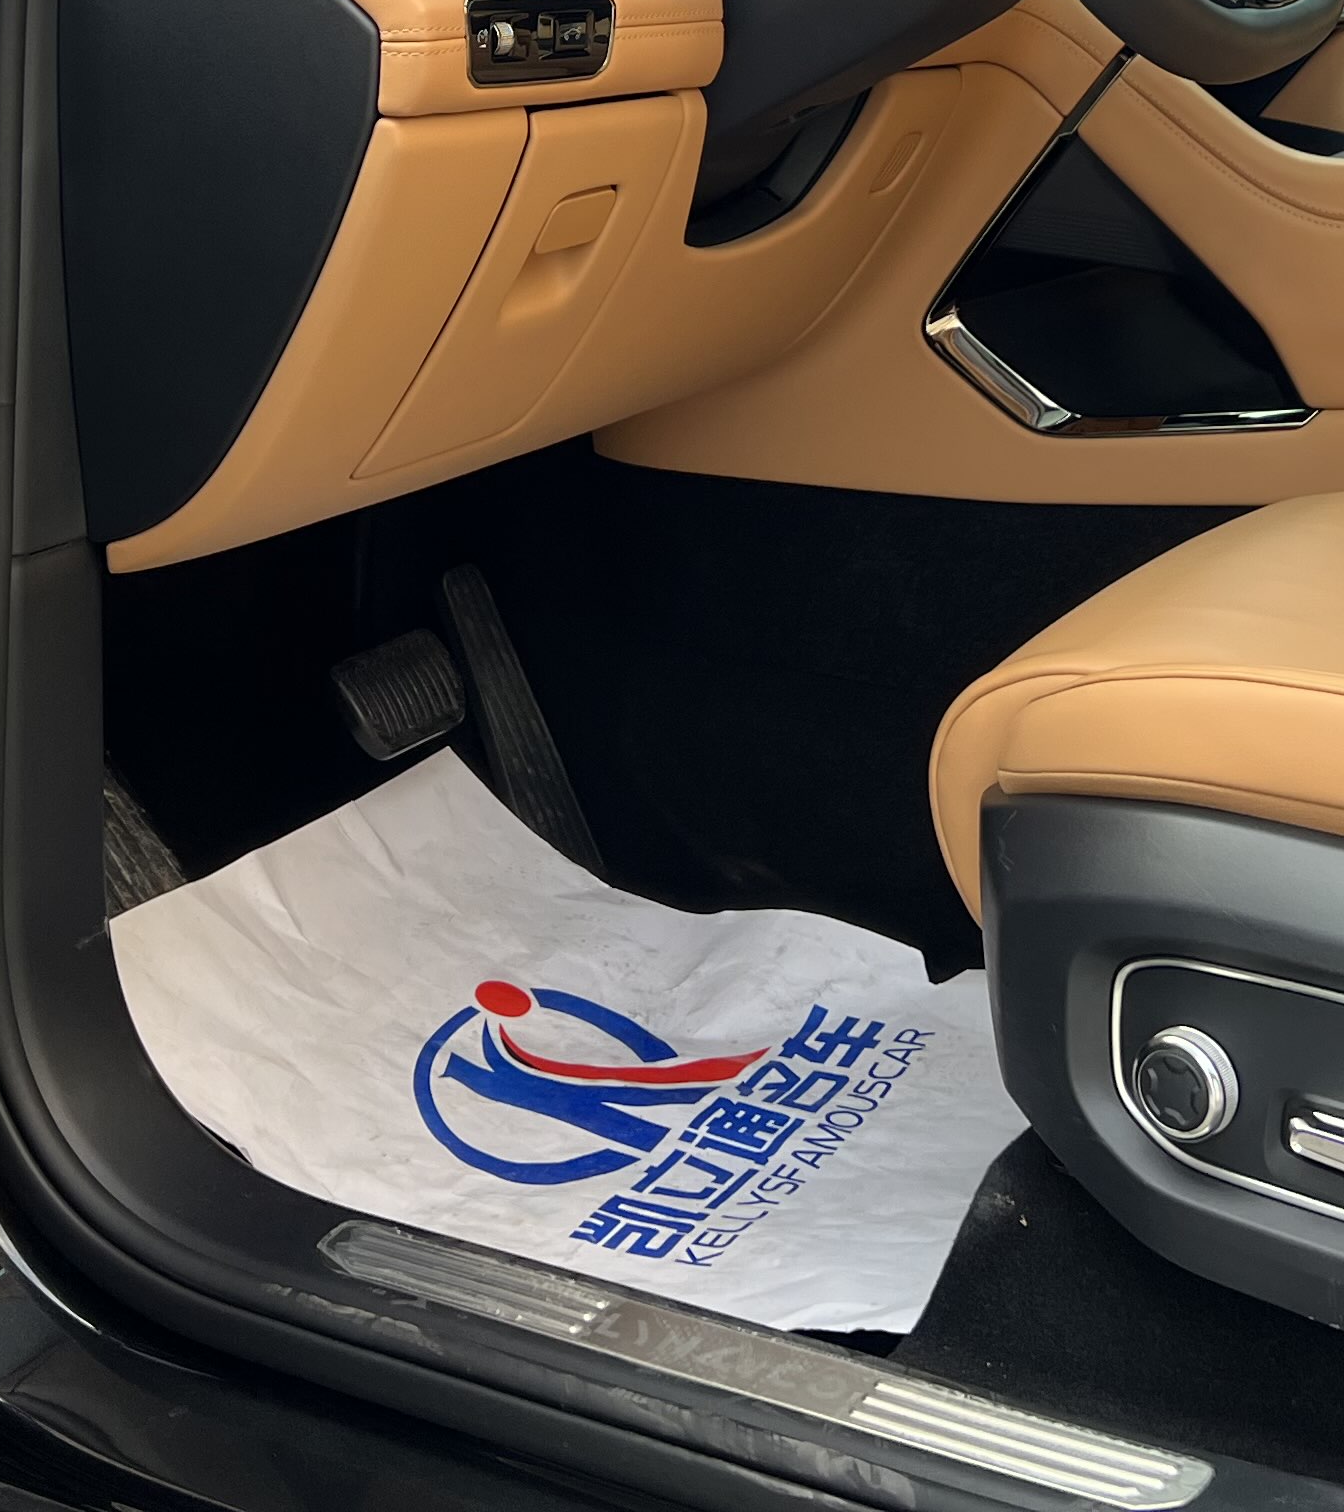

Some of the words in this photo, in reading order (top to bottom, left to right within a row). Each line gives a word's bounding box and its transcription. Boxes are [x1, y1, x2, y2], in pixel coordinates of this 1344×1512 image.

[569, 1003, 886, 1260] 凯立通名车
